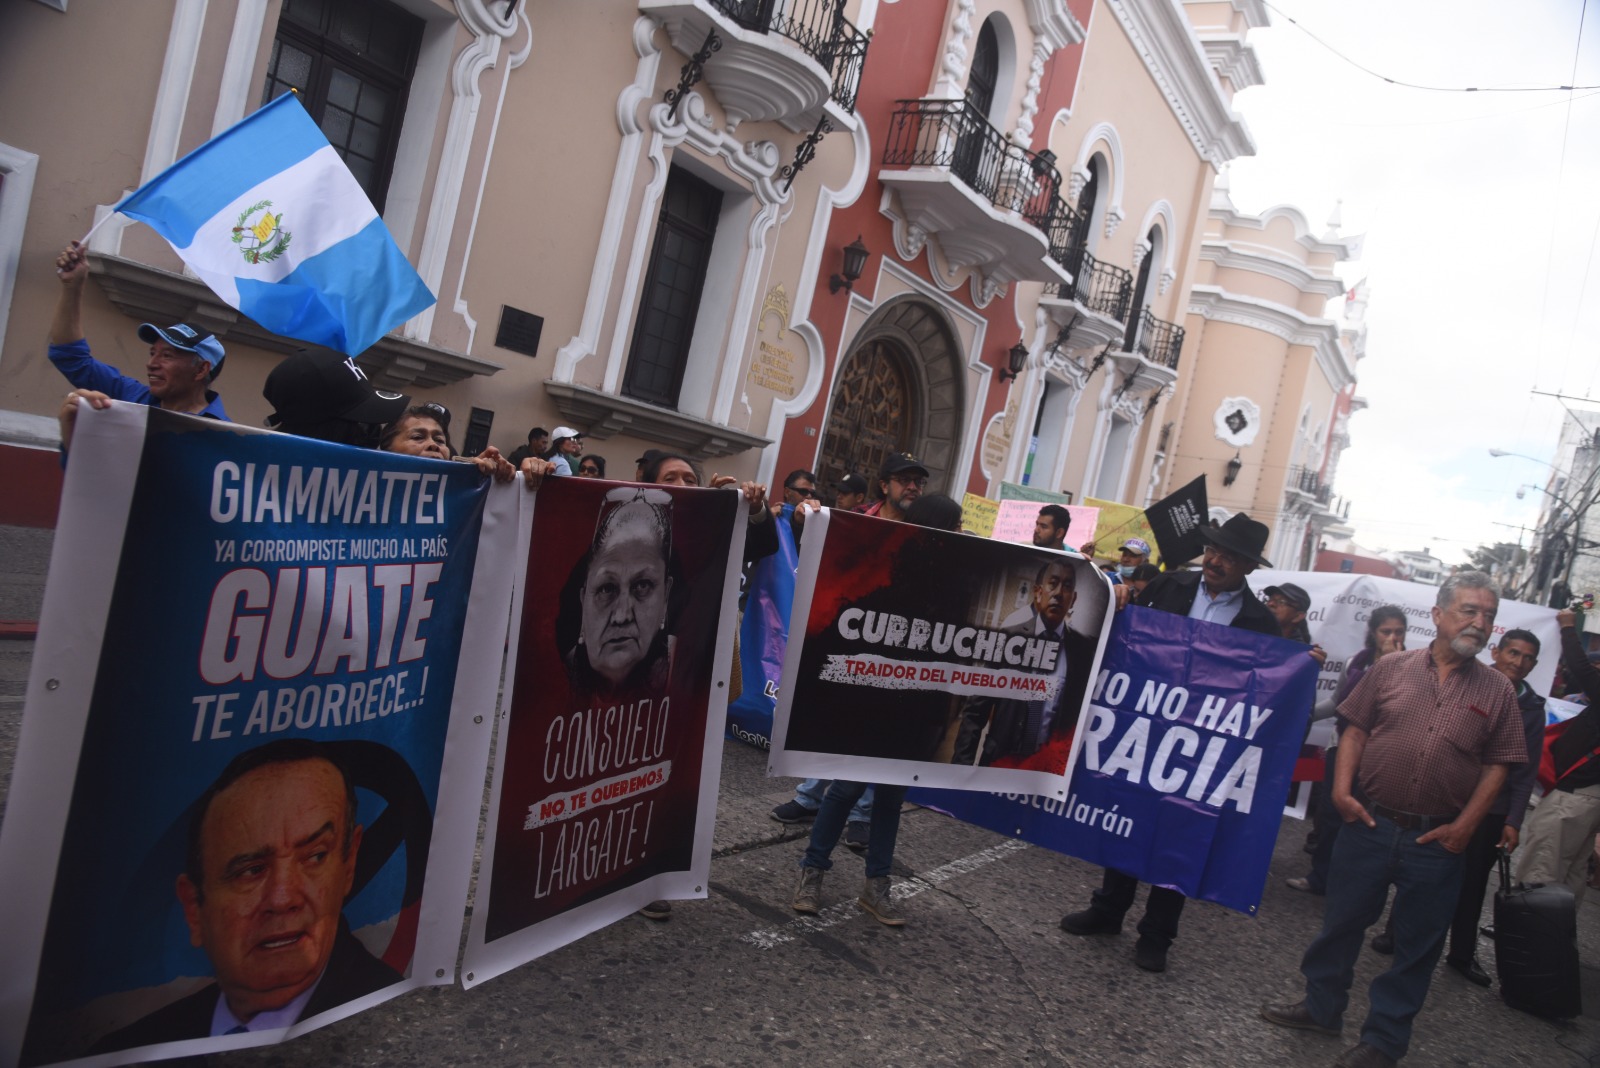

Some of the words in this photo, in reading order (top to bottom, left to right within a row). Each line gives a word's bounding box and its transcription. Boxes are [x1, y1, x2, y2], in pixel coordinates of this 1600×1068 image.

[210, 461, 448, 524] GIAMMATTEI
[215, 540, 235, 562] YA
[240, 538, 347, 562] CORROMPISTE
[350, 538, 398, 559] MUCHO
[402, 538, 418, 558] AL
[421, 534, 449, 557] PAÍS.
[199, 562, 444, 685] GUATE
[1347, 594, 1432, 619] Organiziones
[837, 607, 1060, 671] CURRUCHICHE
[845, 659, 916, 680] TRAIDOR
[919, 667, 948, 684] DEL
[951, 671, 1008, 689] PUEBLO
[1010, 677, 1047, 693] MAYA
[192, 692, 241, 742] TE
[543, 696, 670, 783] CONSUELO
[732, 724, 756, 745] Los
[1135, 679, 1189, 721] NO
[1194, 694, 1274, 740] HAY
[1080, 703, 1264, 814] RACIA
[540, 802, 565, 820] NO
[570, 791, 587, 811] TE
[534, 800, 654, 899] LARGATE!
